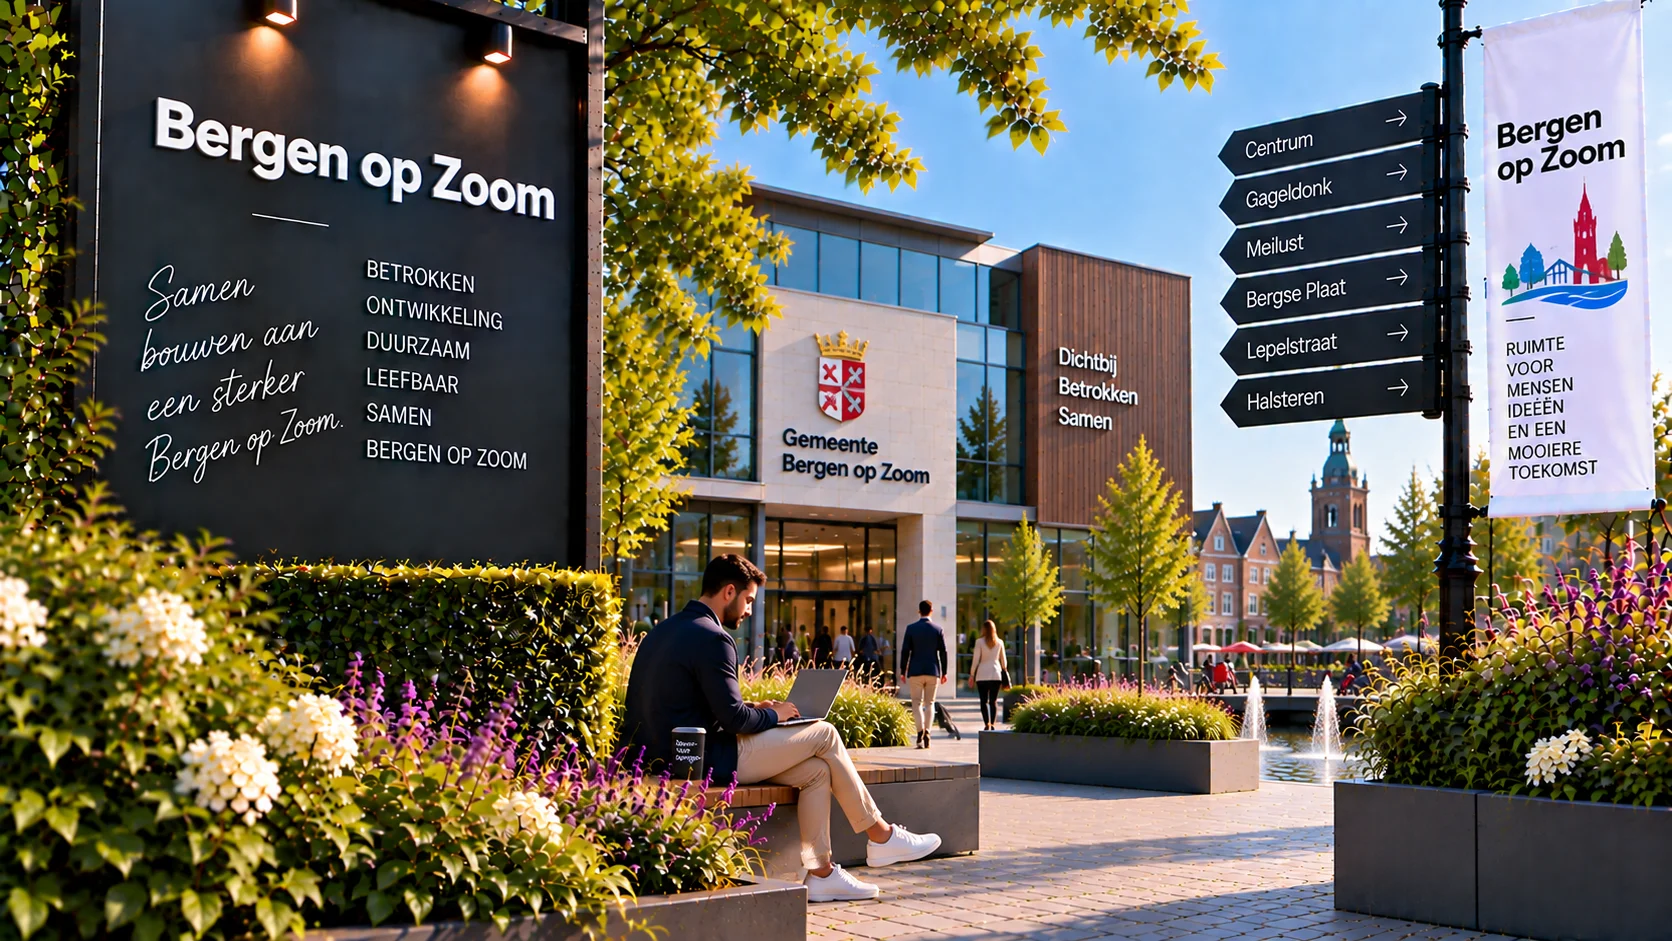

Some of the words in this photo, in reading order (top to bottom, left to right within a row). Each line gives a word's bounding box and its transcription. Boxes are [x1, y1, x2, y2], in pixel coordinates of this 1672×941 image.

[1497, 109, 1602, 149] Bergen
[155, 96, 349, 181] Bergen
[360, 152, 422, 203] op
[431, 153, 556, 220] Zoom
[1245, 133, 1314, 159] Centrum
[1497, 157, 1534, 184] op
[1540, 139, 1625, 173] Zoom
[1246, 177, 1333, 209] Gageldonk
[1246, 233, 1304, 258] Meilust
[367, 259, 475, 293] BETROKKEN
[145, 264, 255, 321] Samen
[1246, 288, 1302, 309] Bergse
[1306, 278, 1347, 300] Plaat
[366, 295, 503, 331] ONTWIKKELING
[141, 328, 253, 372] bouwen
[263, 320, 319, 346] aan
[367, 331, 470, 360] DUURZAAM
[1247, 333, 1338, 362] Lepelstraat
[1506, 336, 1565, 356] RUIMTE
[1059, 346, 1117, 378] Dichtbij
[1506, 358, 1554, 377] VOOR
[147, 393, 201, 421] een
[211, 359, 306, 413] sterker
[367, 367, 459, 394] LEEFBAAR
[1059, 376, 1138, 406] Betrokken
[1507, 377, 1574, 398] MENSEN
[366, 402, 432, 427] SAMEN
[1247, 389, 1324, 411] Halsteren
[1058, 406, 1113, 431] Samen
[1508, 424, 1528, 439] EN
[1535, 420, 1566, 437] EEN
[145, 433, 241, 484] Bergen
[247, 429, 274, 466] op
[280, 408, 344, 445] Zoom.
[367, 439, 441, 463] BERGEN
[447, 446, 472, 465] OP
[477, 448, 527, 470] ZOOM
[782, 428, 878, 455] Gemeente
[1508, 441, 1582, 460] MOOIERE
[782, 453, 848, 480] Bergen
[853, 463, 877, 484] op
[881, 462, 930, 484] Zoom
[1509, 460, 1598, 480] TOEKOMST
